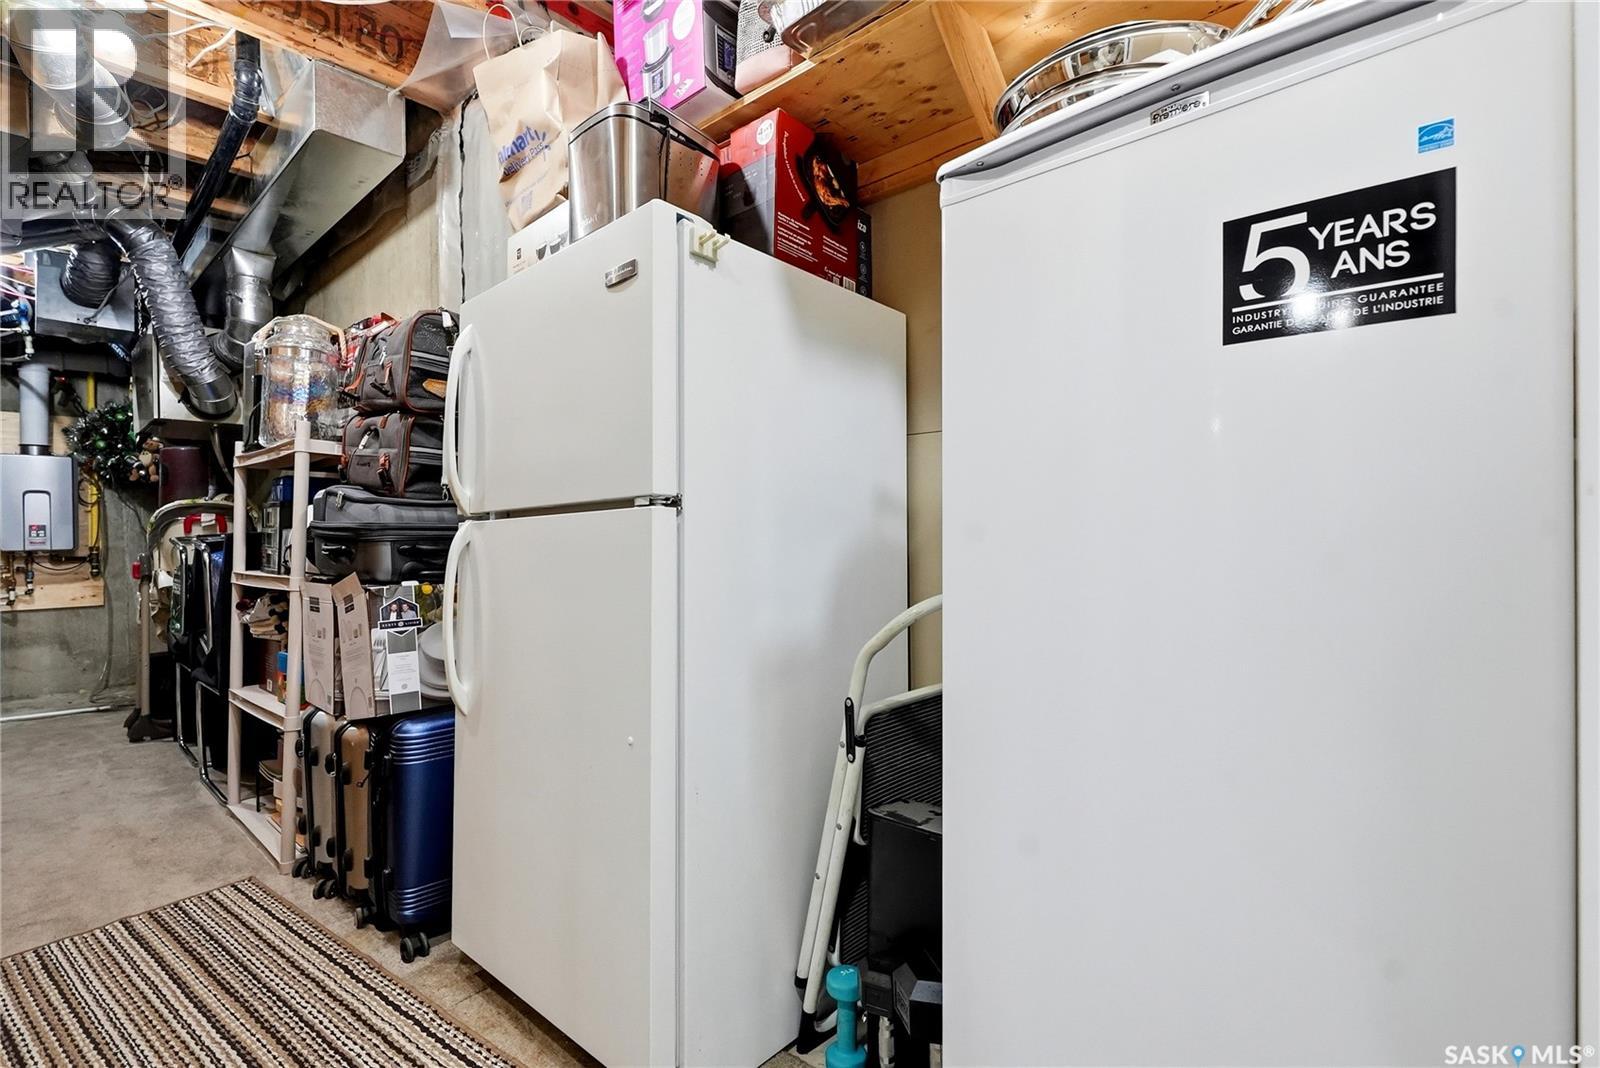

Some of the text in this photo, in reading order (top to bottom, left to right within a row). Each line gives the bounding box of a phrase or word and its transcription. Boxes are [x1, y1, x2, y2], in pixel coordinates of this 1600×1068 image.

[1238, 201, 1438, 301] 5 YEARS
[1330, 239, 1411, 279] ANS
[1231, 308, 1289, 324] INDUSTRY
[1357, 282, 1445, 304] GUARANTEE
[1231, 320, 1283, 335] GARANTIE
[1353, 306, 1370, 316] DE
[1372, 295, 1445, 314] L'INDUSTRIE
